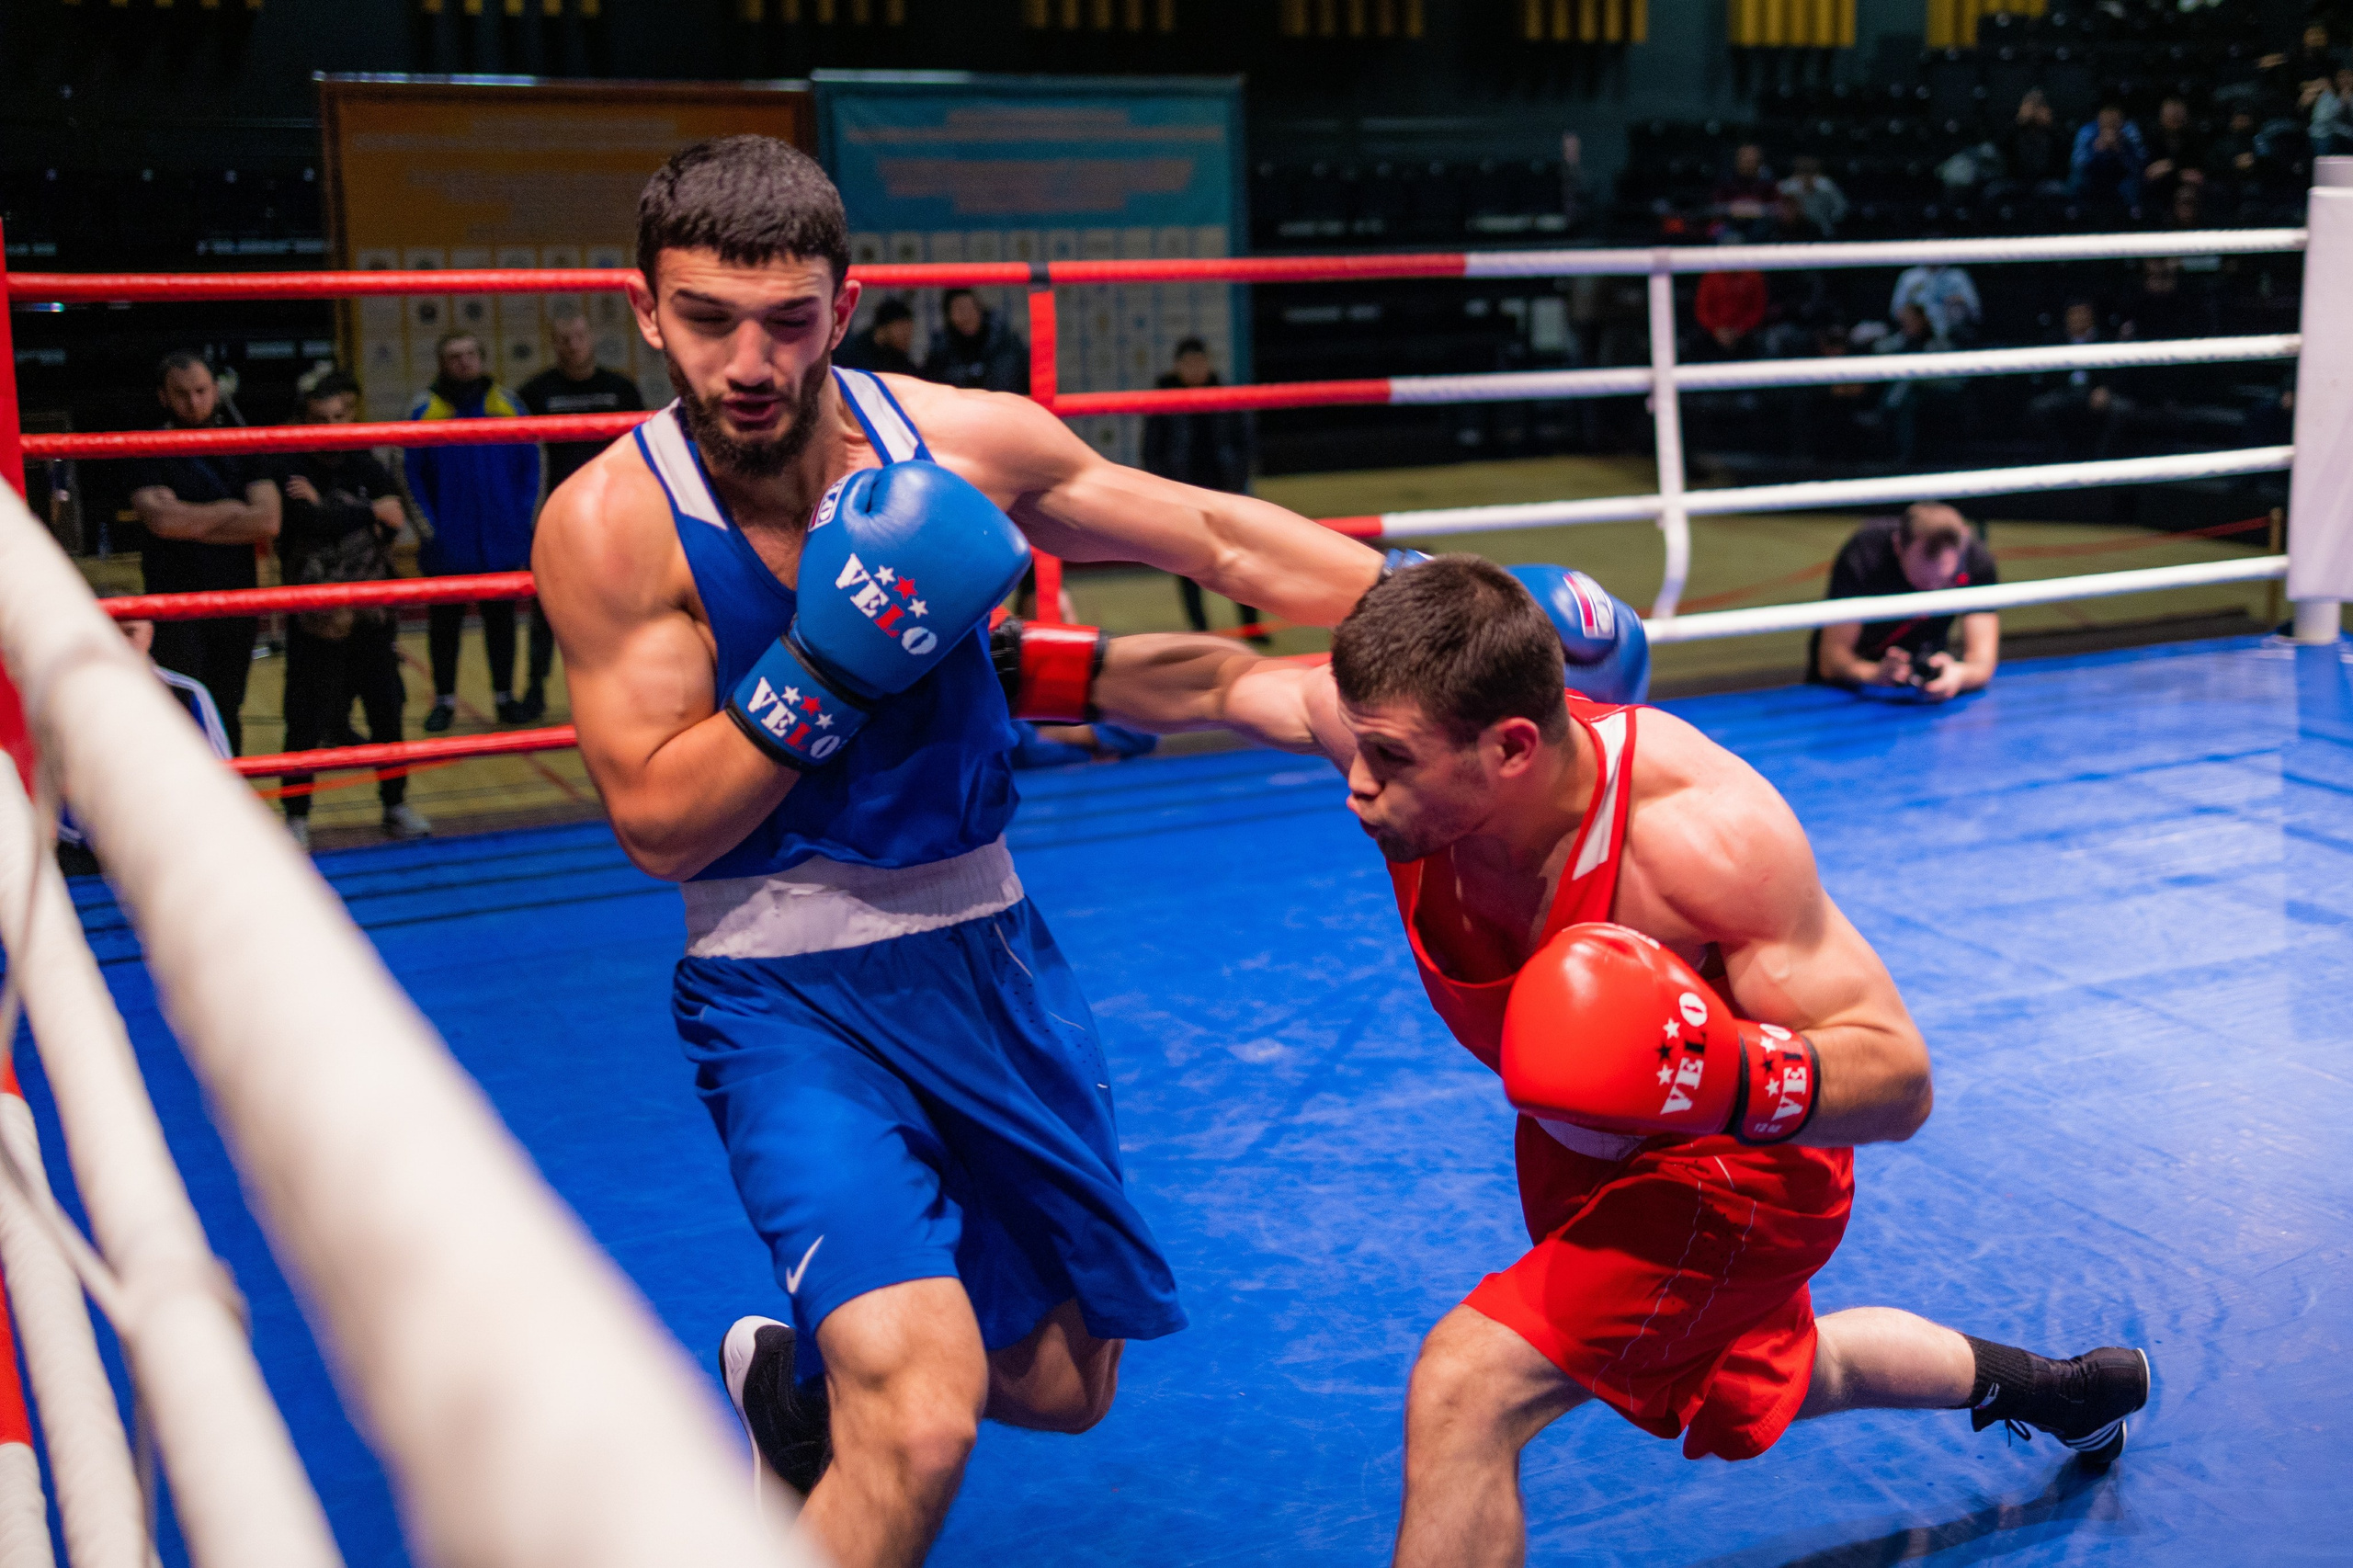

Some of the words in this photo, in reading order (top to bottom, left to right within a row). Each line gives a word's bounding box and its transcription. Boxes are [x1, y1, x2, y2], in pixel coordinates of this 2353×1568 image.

[835, 553, 938, 655] VELO
[747, 676, 840, 758] VELO
[1660, 992, 1708, 1115] VELO
